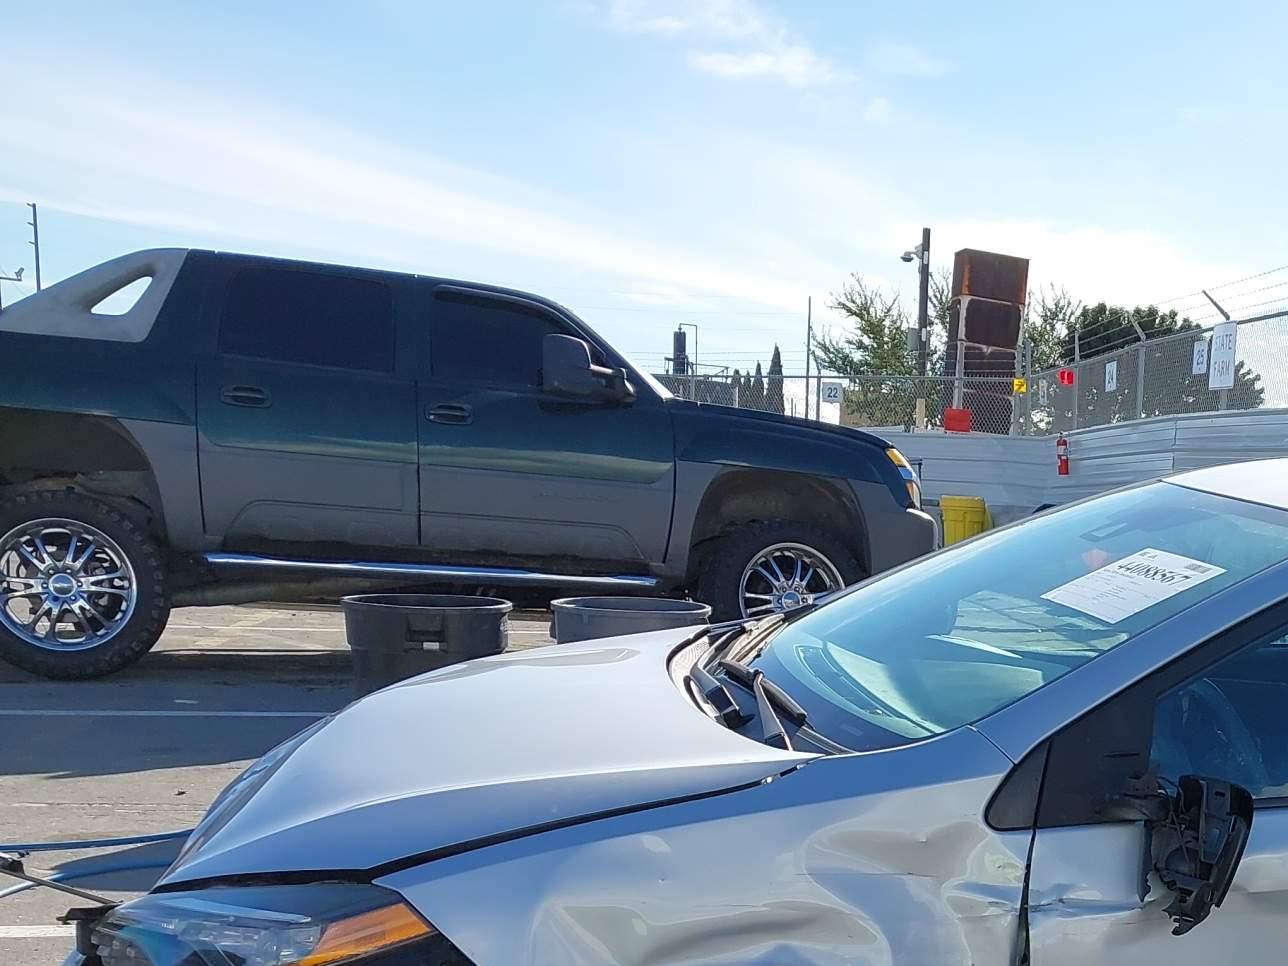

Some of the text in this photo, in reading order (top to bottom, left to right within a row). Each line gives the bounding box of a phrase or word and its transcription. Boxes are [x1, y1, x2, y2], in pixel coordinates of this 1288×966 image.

[1214, 333, 1233, 351] STATE
[1196, 348, 1205, 366] 25
[1213, 360, 1231, 376] FARM
[827, 387, 838, 398] 22
[1117, 562, 1192, 585] 44088567
